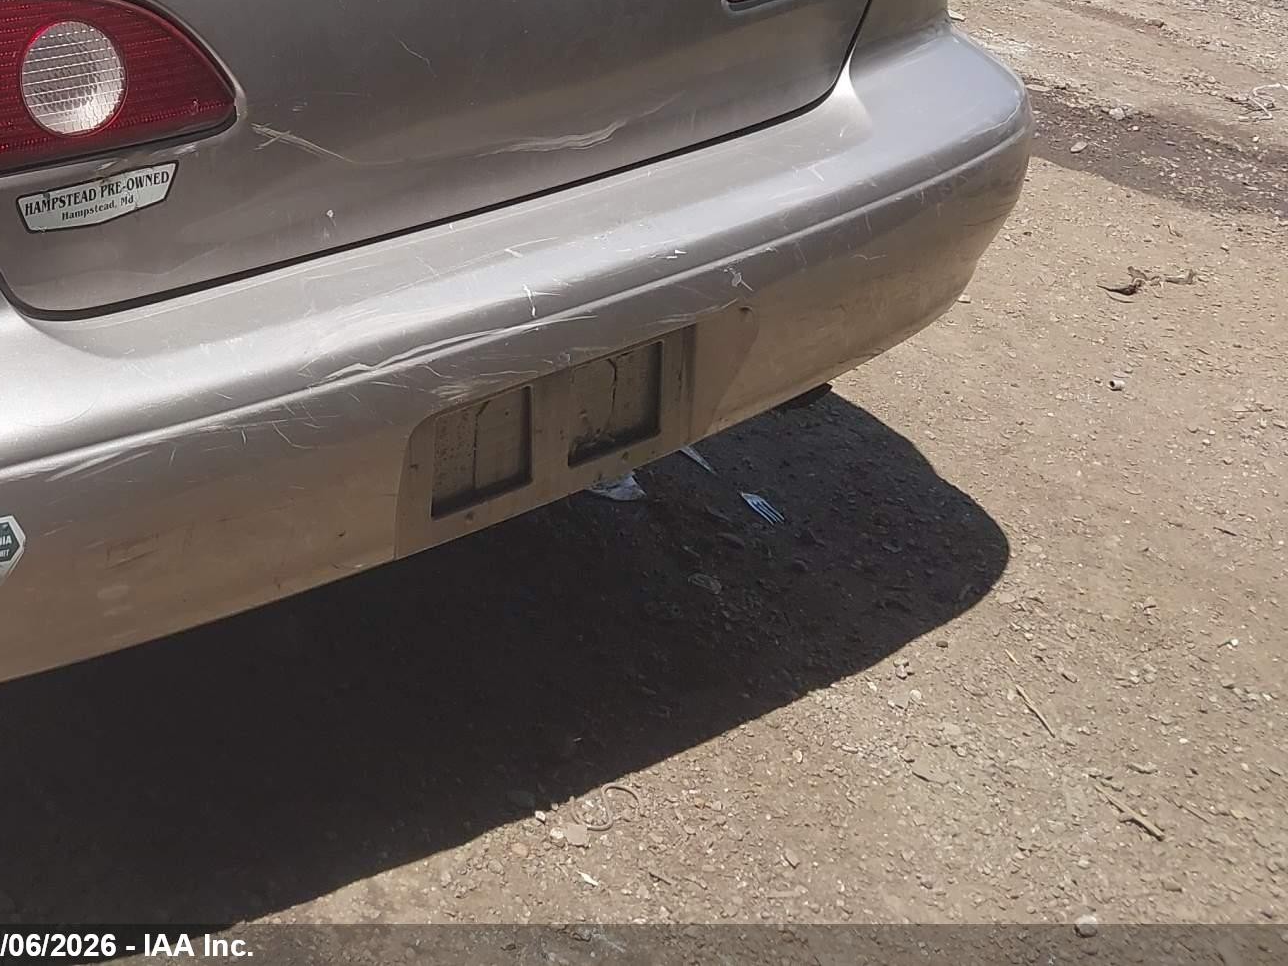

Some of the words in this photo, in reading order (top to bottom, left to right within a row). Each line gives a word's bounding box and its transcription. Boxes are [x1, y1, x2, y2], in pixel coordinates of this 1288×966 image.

[25, 188, 97, 217] HAMPSTEAD
[100, 171, 170, 198] PRE-OWNED
[62, 200, 118, 221] Hampstead,
[120, 195, 134, 207] Md
